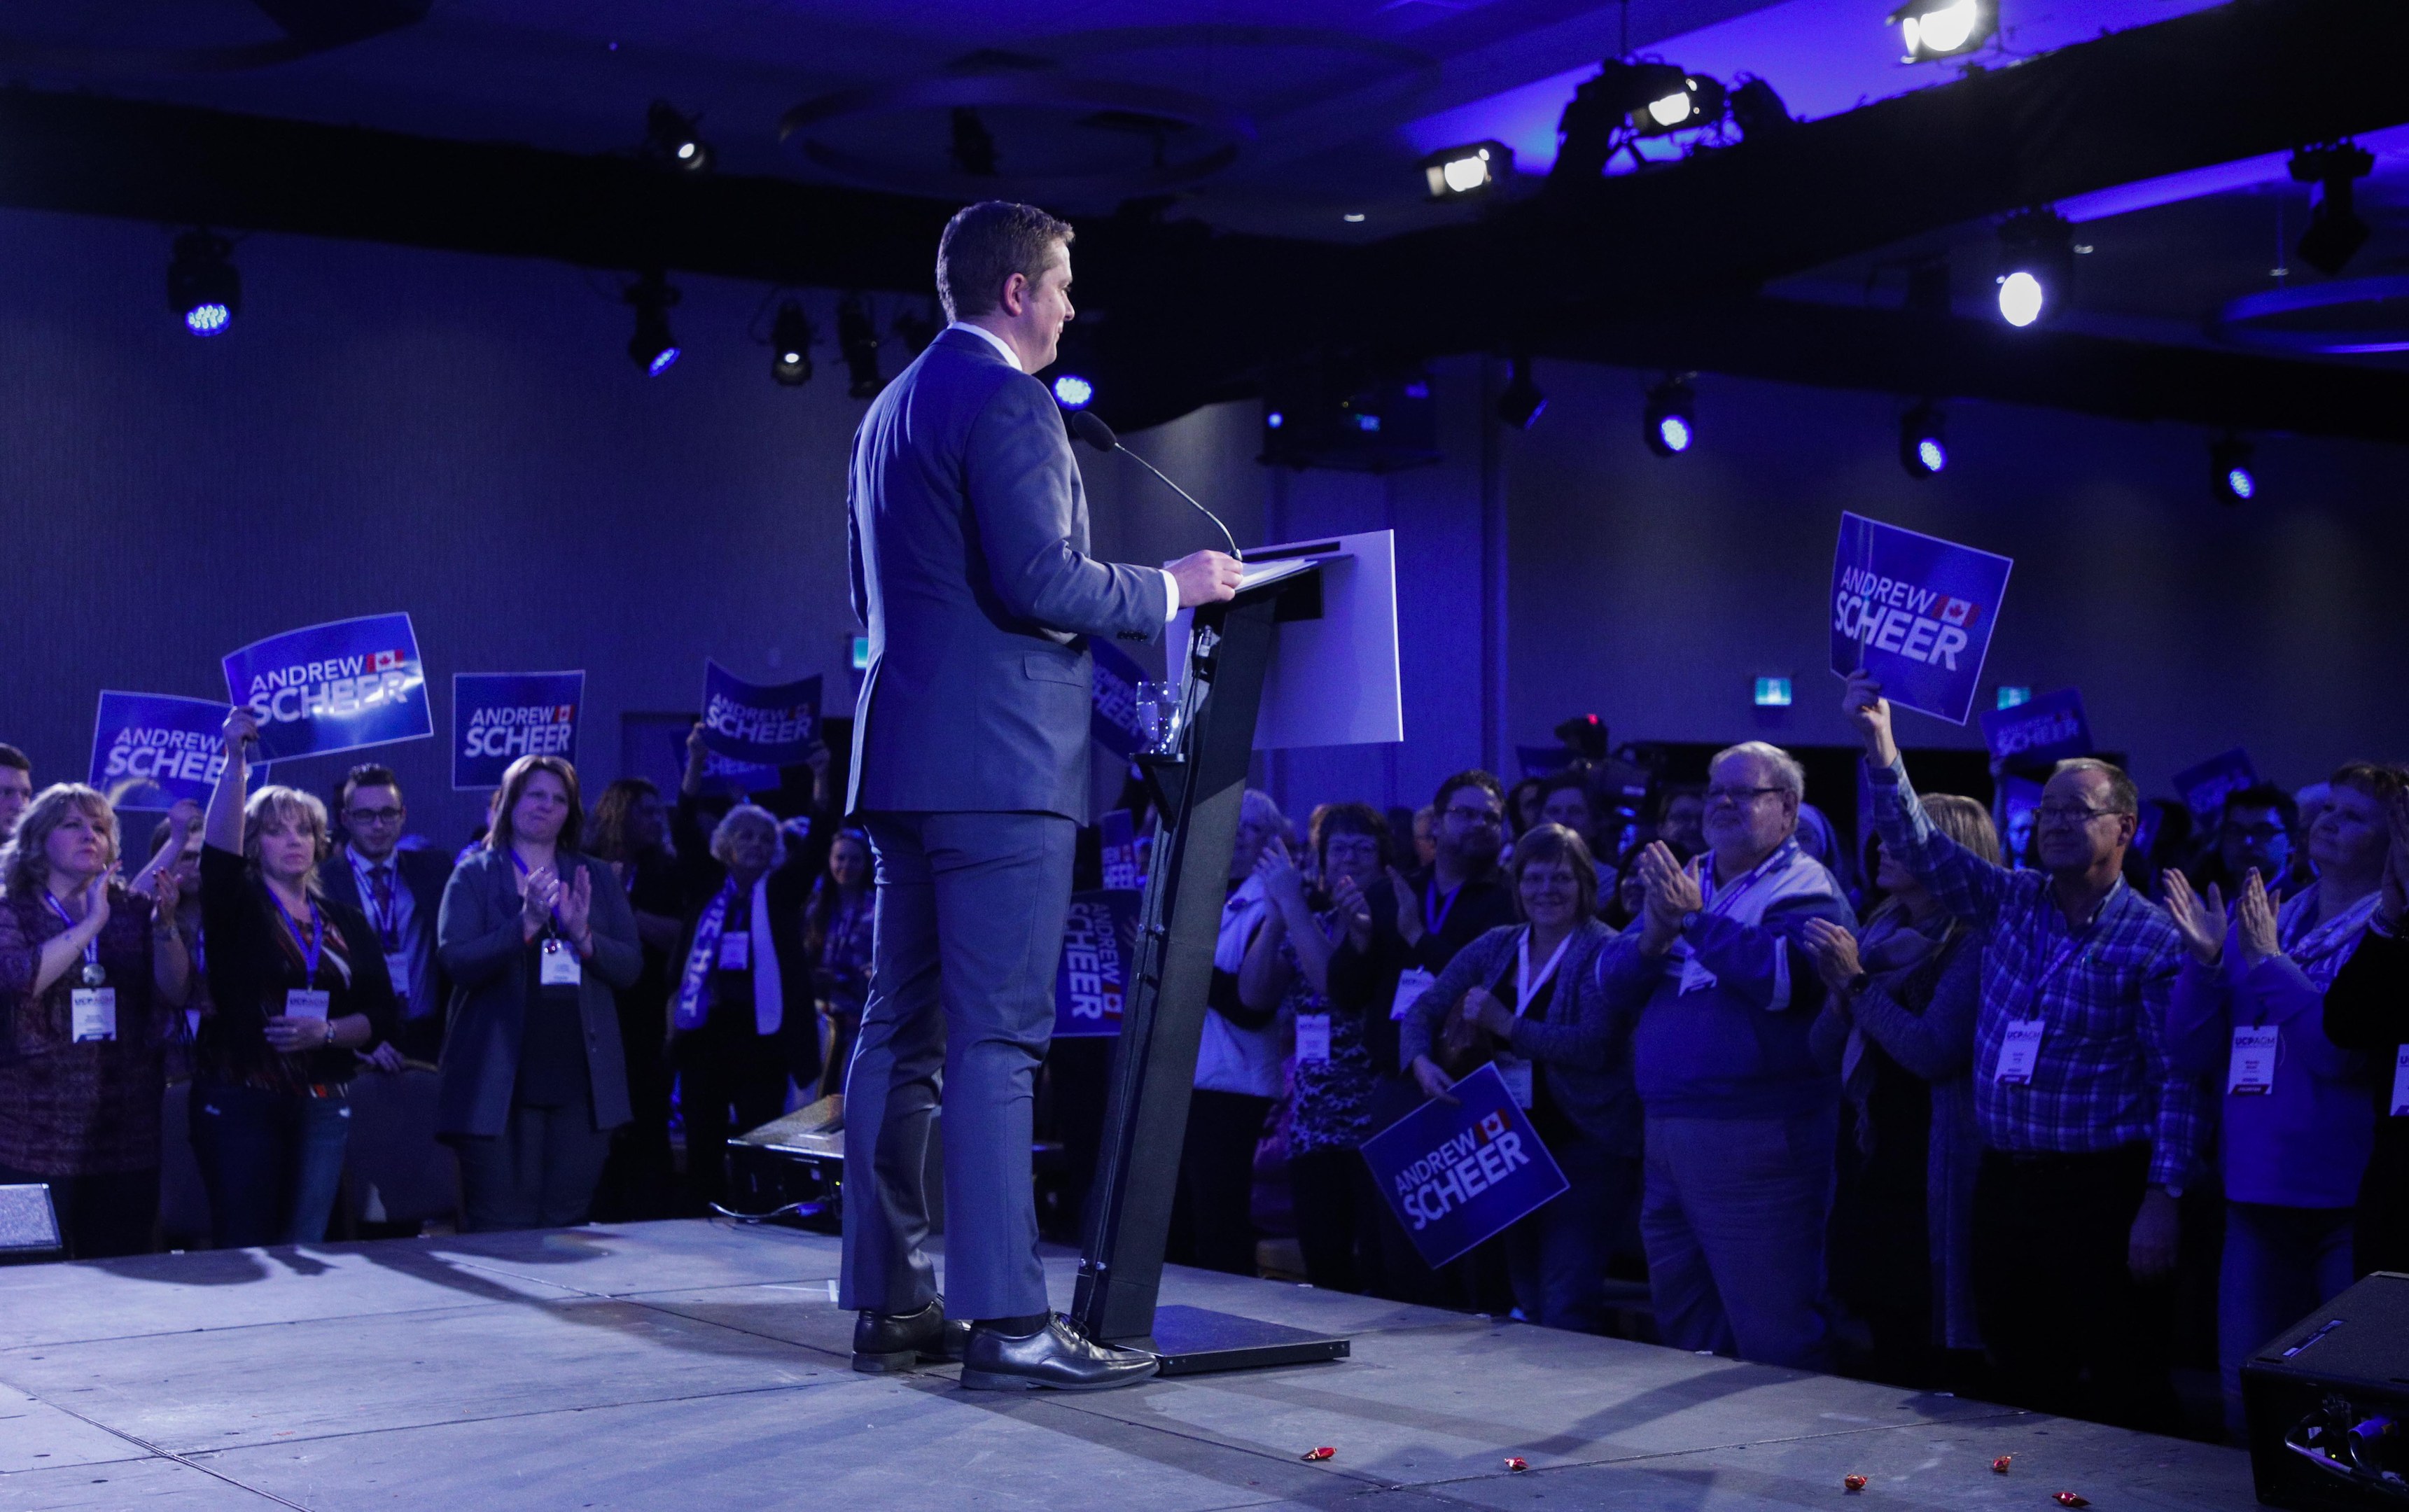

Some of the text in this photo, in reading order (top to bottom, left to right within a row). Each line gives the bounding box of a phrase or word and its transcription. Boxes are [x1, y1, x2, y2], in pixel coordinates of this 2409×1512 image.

[1841, 564, 1938, 615] ANDREW
[1834, 590, 1969, 672] SCHEER
[249, 654, 364, 695] ANDREW
[248, 670, 408, 728] SCHEER
[470, 705, 555, 727] ANDREW
[711, 692, 790, 722] ANDREW
[114, 726, 225, 754] ANDREW
[463, 723, 573, 758] SCHEER
[706, 705, 813, 745] SCHEER
[104, 744, 252, 785] SCHEE
[1089, 901, 1121, 985] ANDREW
[2235, 1037, 2275, 1045] UCPAGM
[1395, 1127, 1476, 1196] ANDREW
[1403, 1130, 1531, 1231] SCHEER
